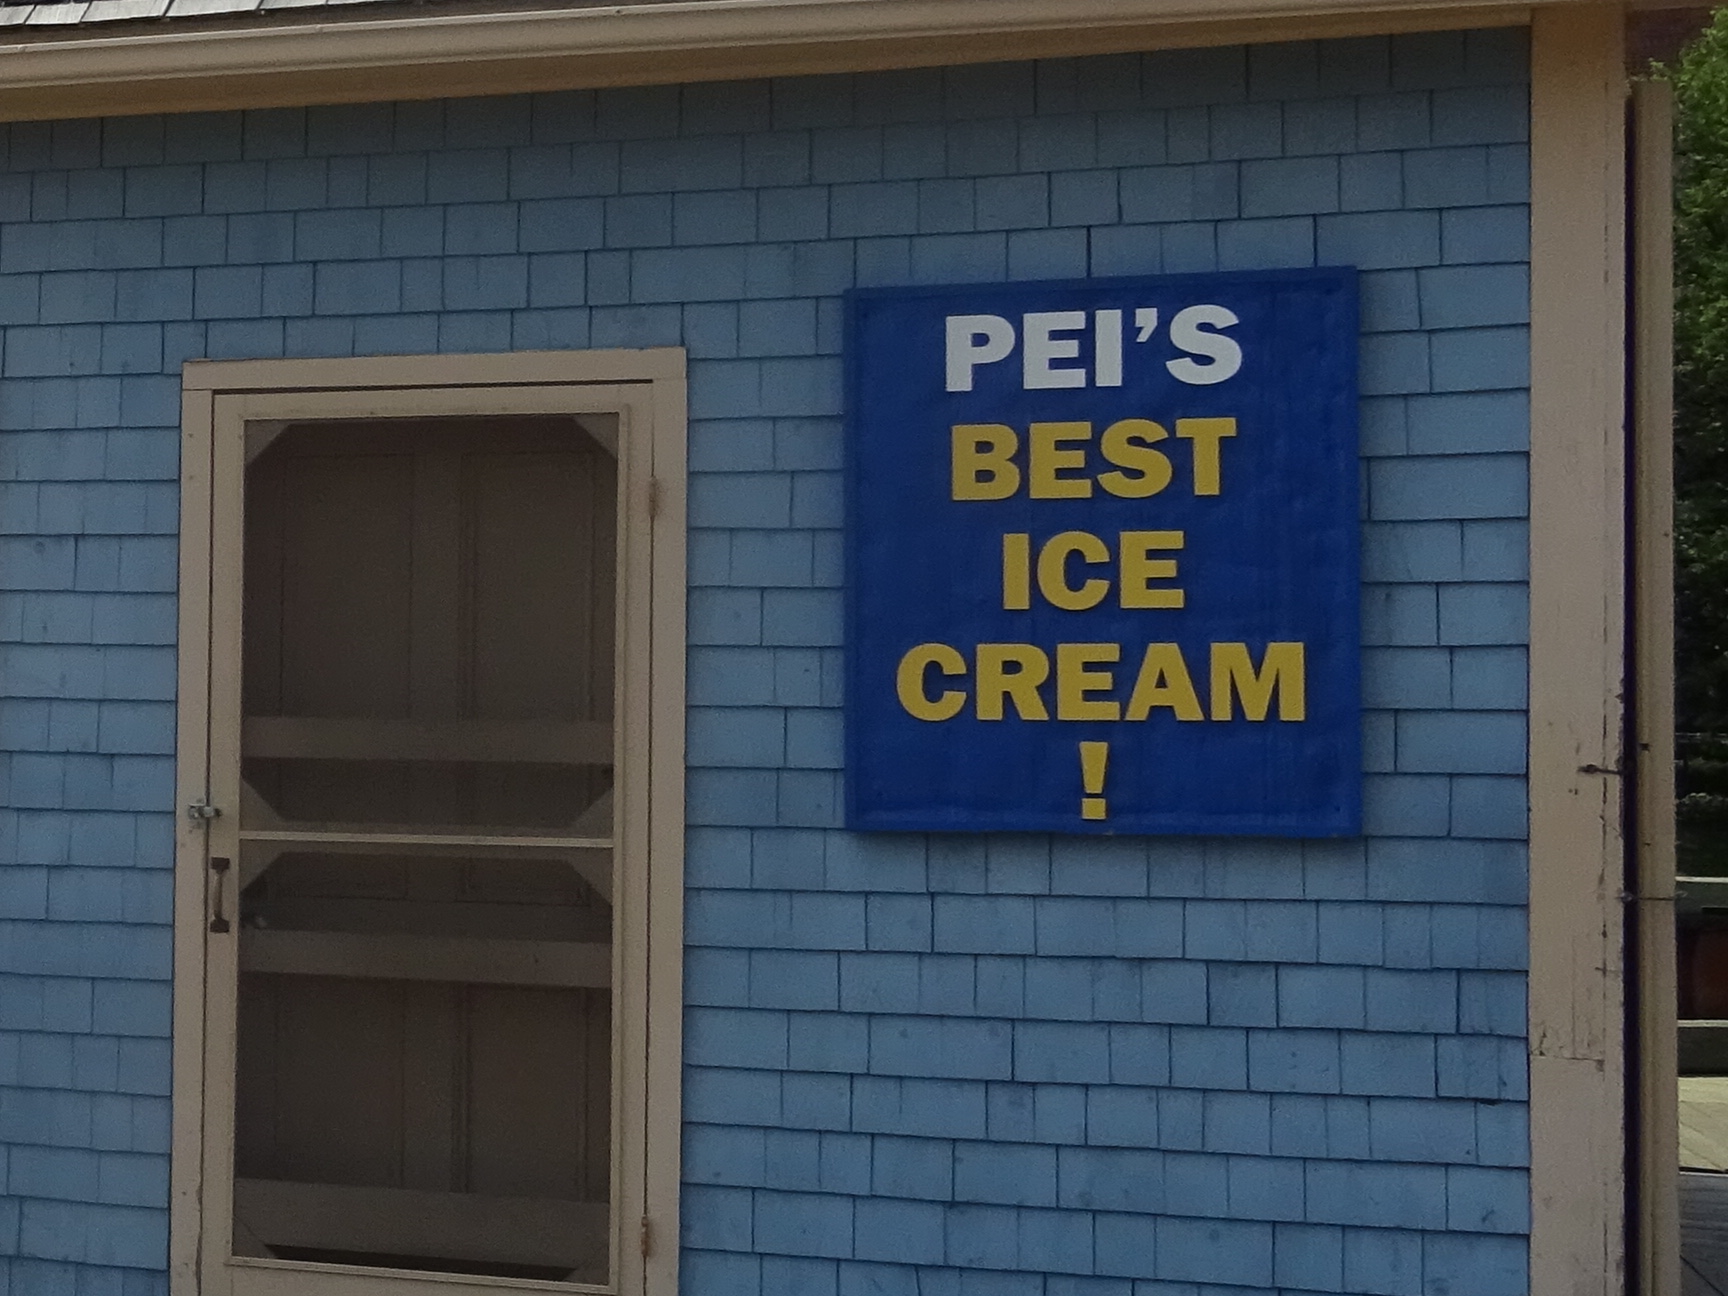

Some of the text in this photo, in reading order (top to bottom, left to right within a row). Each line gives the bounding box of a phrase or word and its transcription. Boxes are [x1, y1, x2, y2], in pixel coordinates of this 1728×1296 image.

[945, 304, 1243, 392] PEI'S
[951, 417, 1237, 501] BEST
[1002, 530, 1186, 610] ICE
[896, 641, 1306, 722] CREAM
[1079, 741, 1110, 820] !
